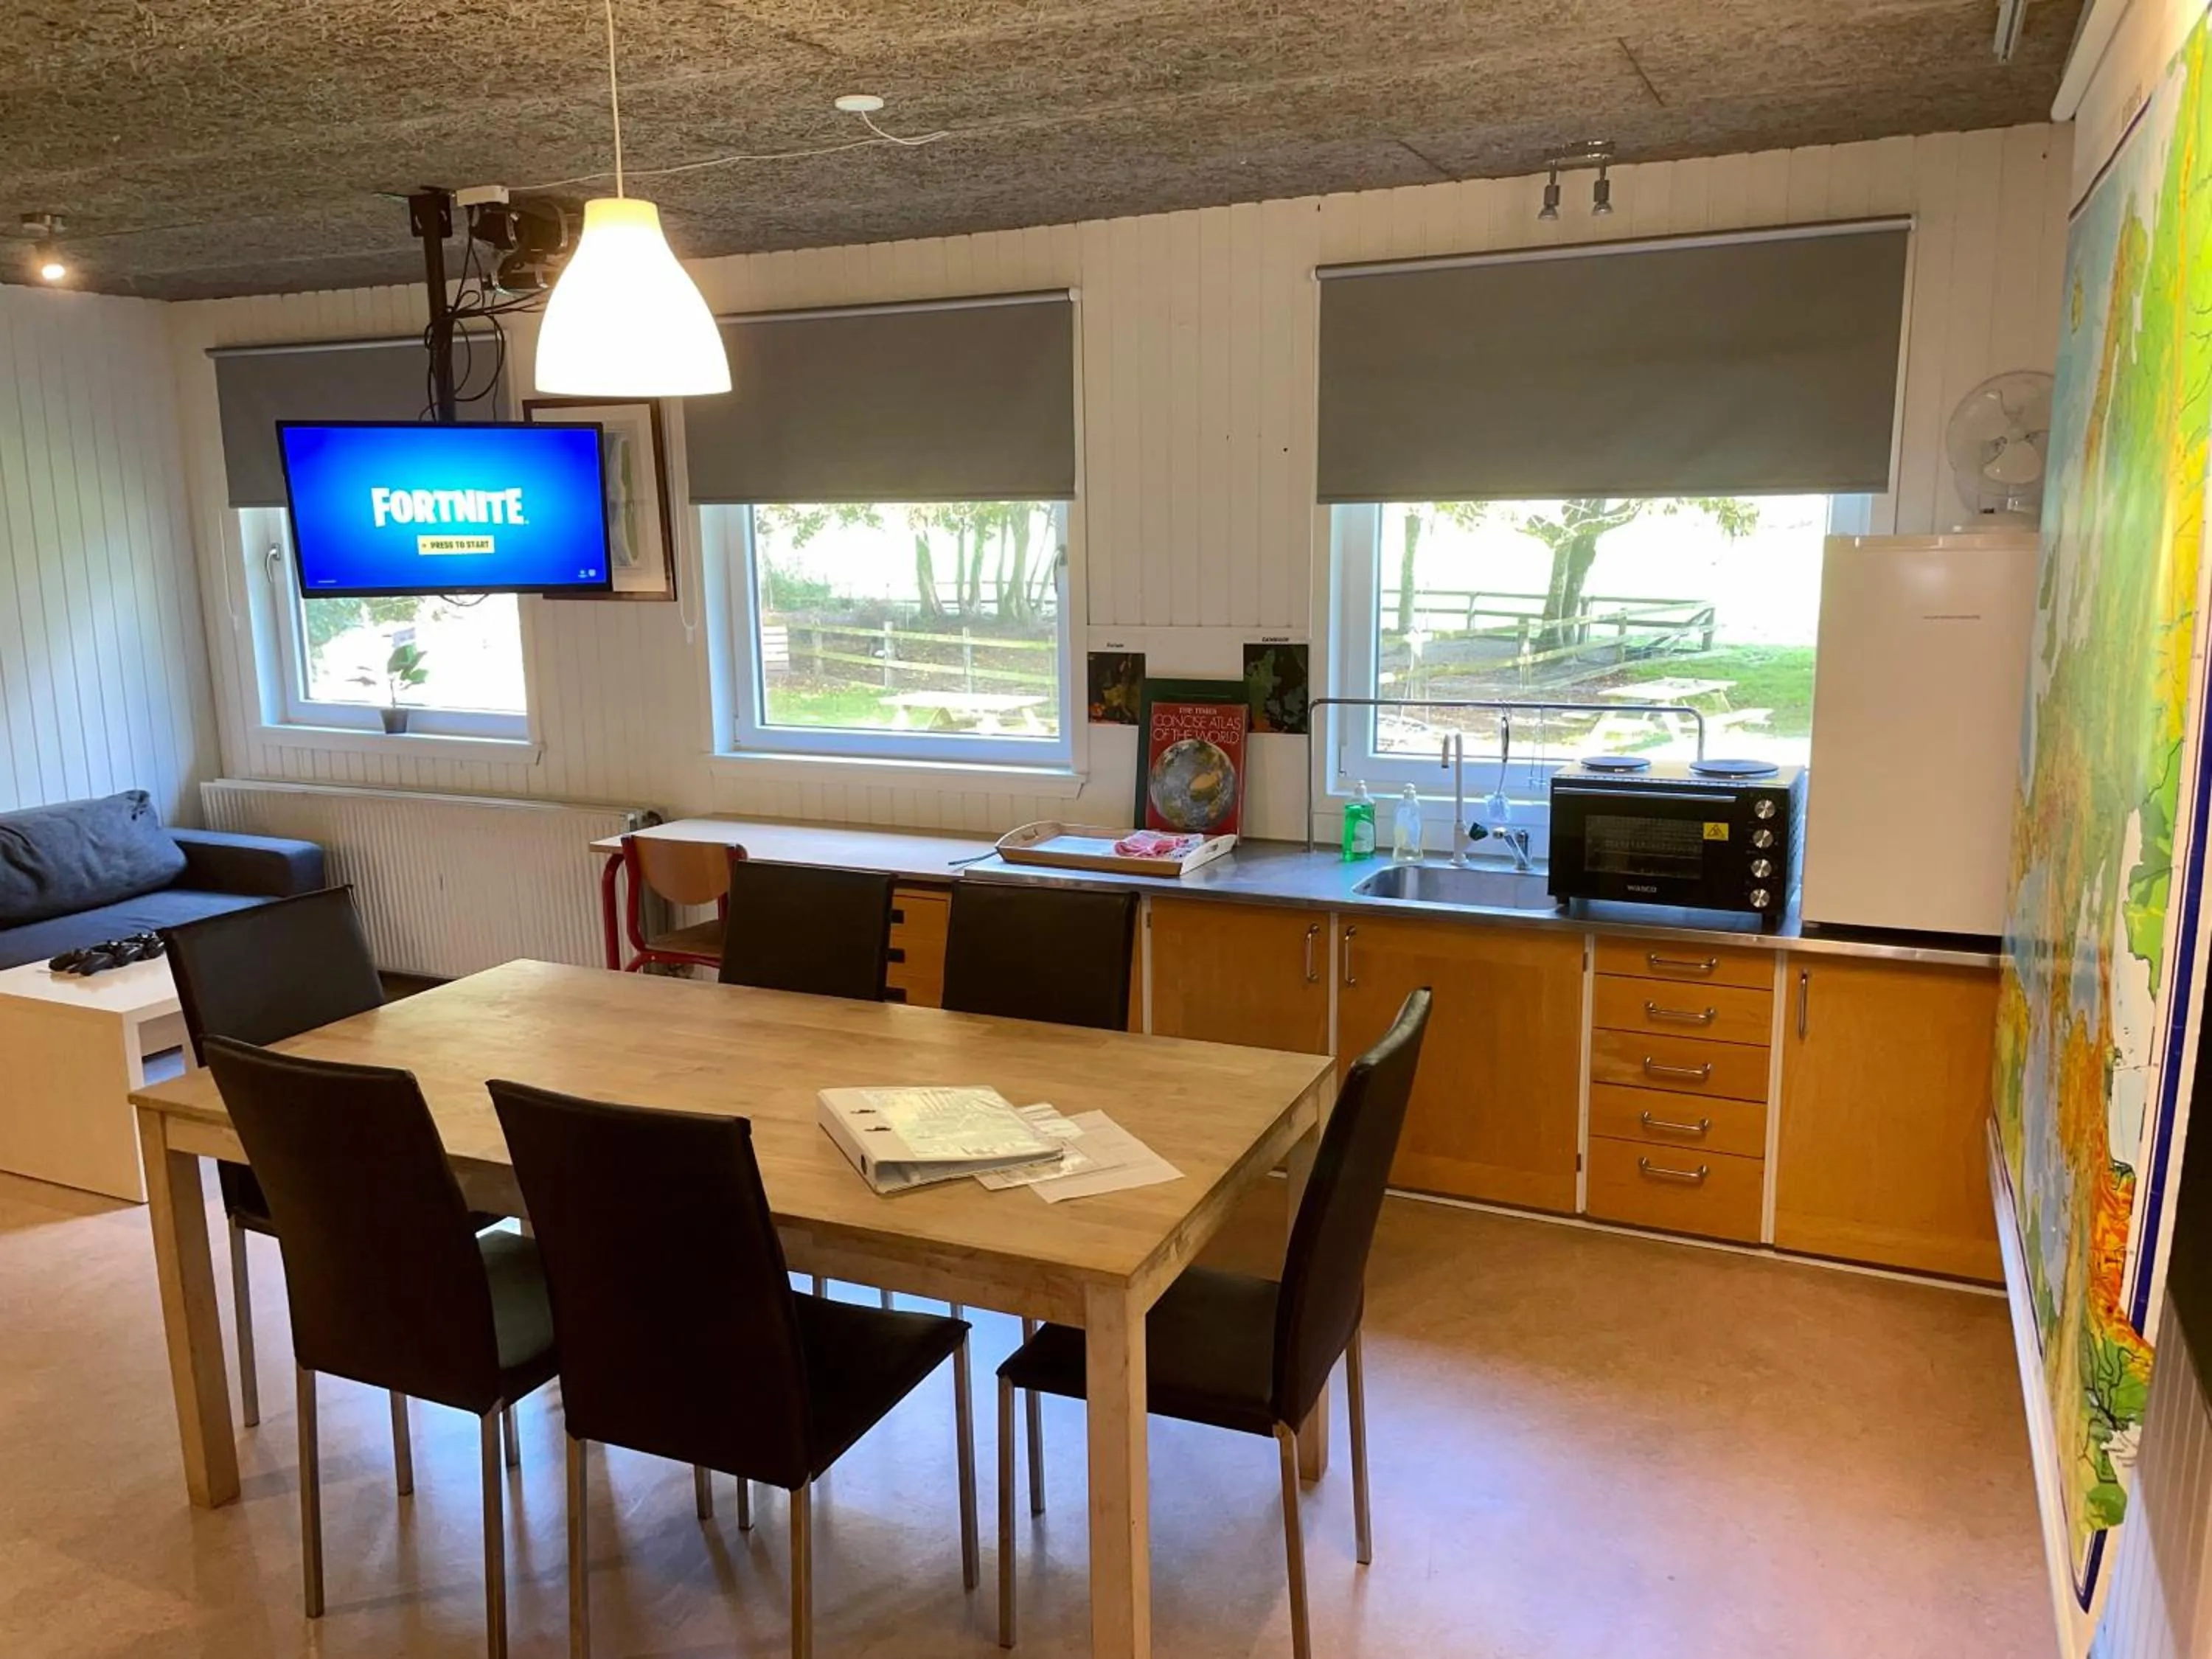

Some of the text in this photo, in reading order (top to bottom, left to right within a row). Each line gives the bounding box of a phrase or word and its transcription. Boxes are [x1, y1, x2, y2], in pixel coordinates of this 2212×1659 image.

[371, 487, 524, 528] FORTNITE
[430, 540, 490, 549] PRESS TO START
[1153, 714, 1241, 730] CONCISE ATLAS
[1153, 728, 1239, 744] OF THE WORLD
